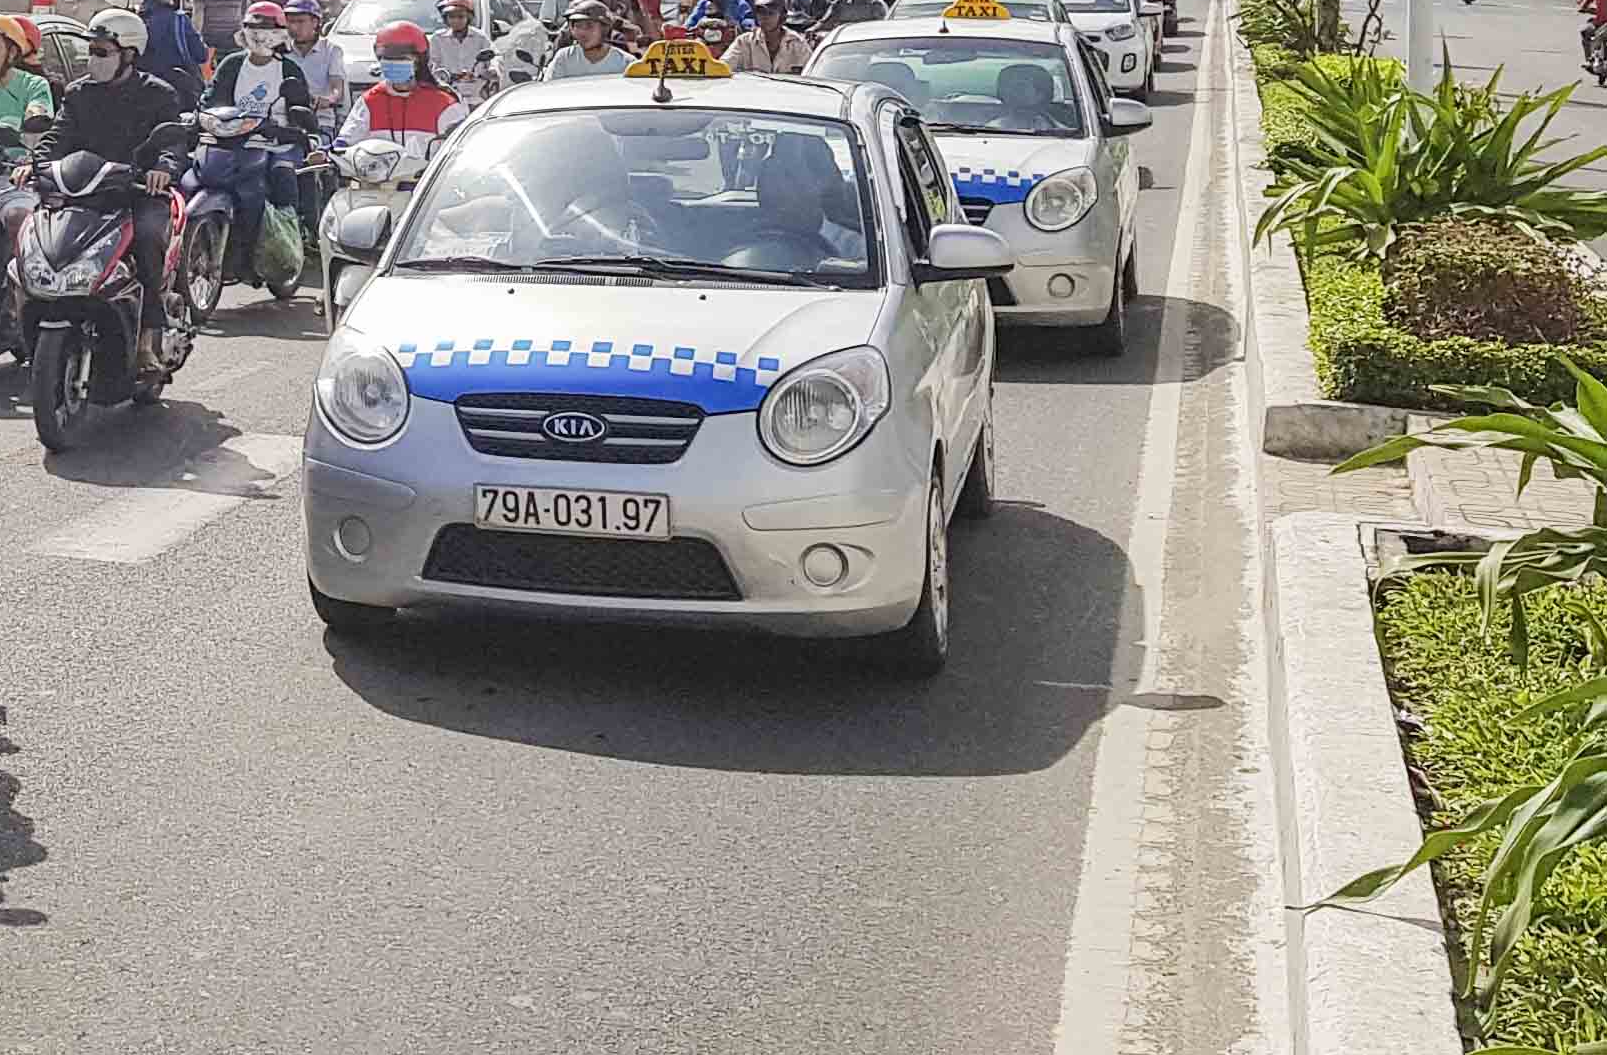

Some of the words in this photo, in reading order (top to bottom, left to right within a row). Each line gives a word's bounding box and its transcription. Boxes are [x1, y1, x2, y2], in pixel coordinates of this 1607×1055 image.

[953, 5, 998, 17] TAXI
[646, 58, 707, 75] TAXI
[553, 418, 594, 436] KIA
[480, 489, 662, 533] 79A-031.97
